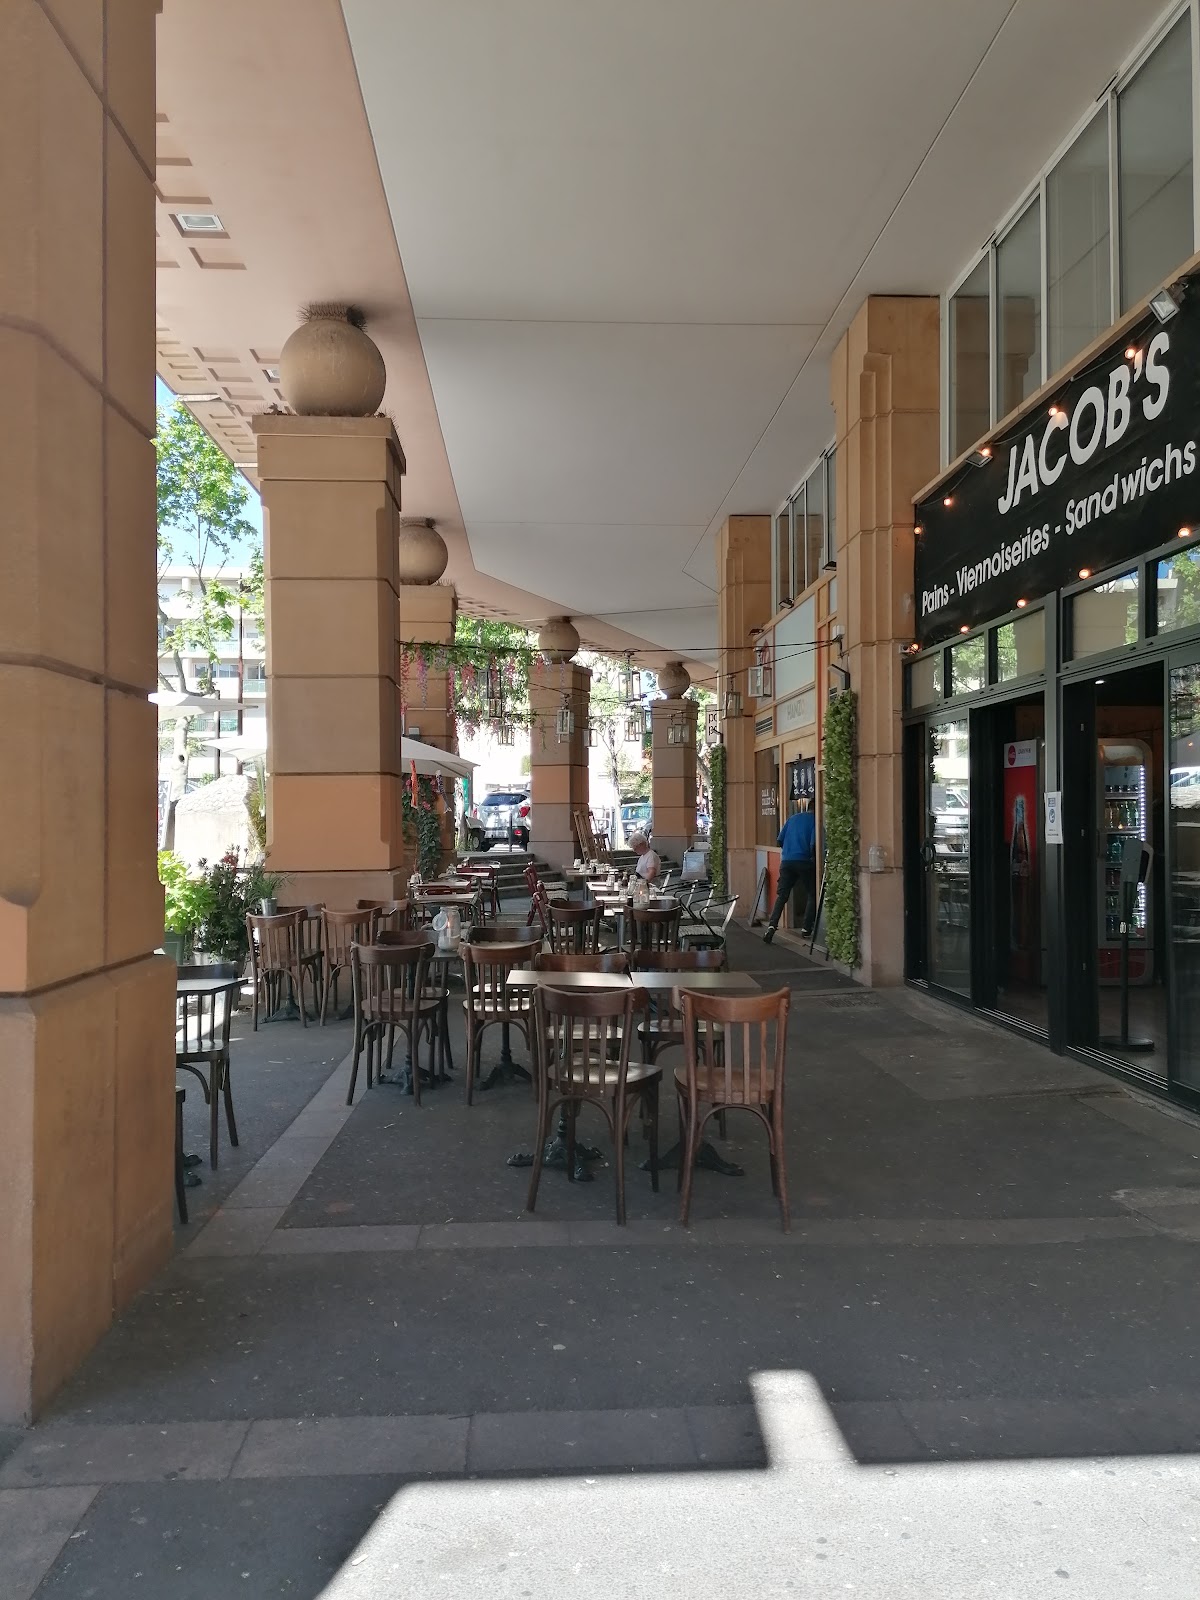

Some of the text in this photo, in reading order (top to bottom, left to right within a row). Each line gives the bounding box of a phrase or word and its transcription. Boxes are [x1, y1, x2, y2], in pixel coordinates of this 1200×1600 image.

[998, 332, 1170, 515] JACOB'S
[956, 523, 1050, 597] Viennoiseries
[1065, 441, 1197, 535] Sandwichs
